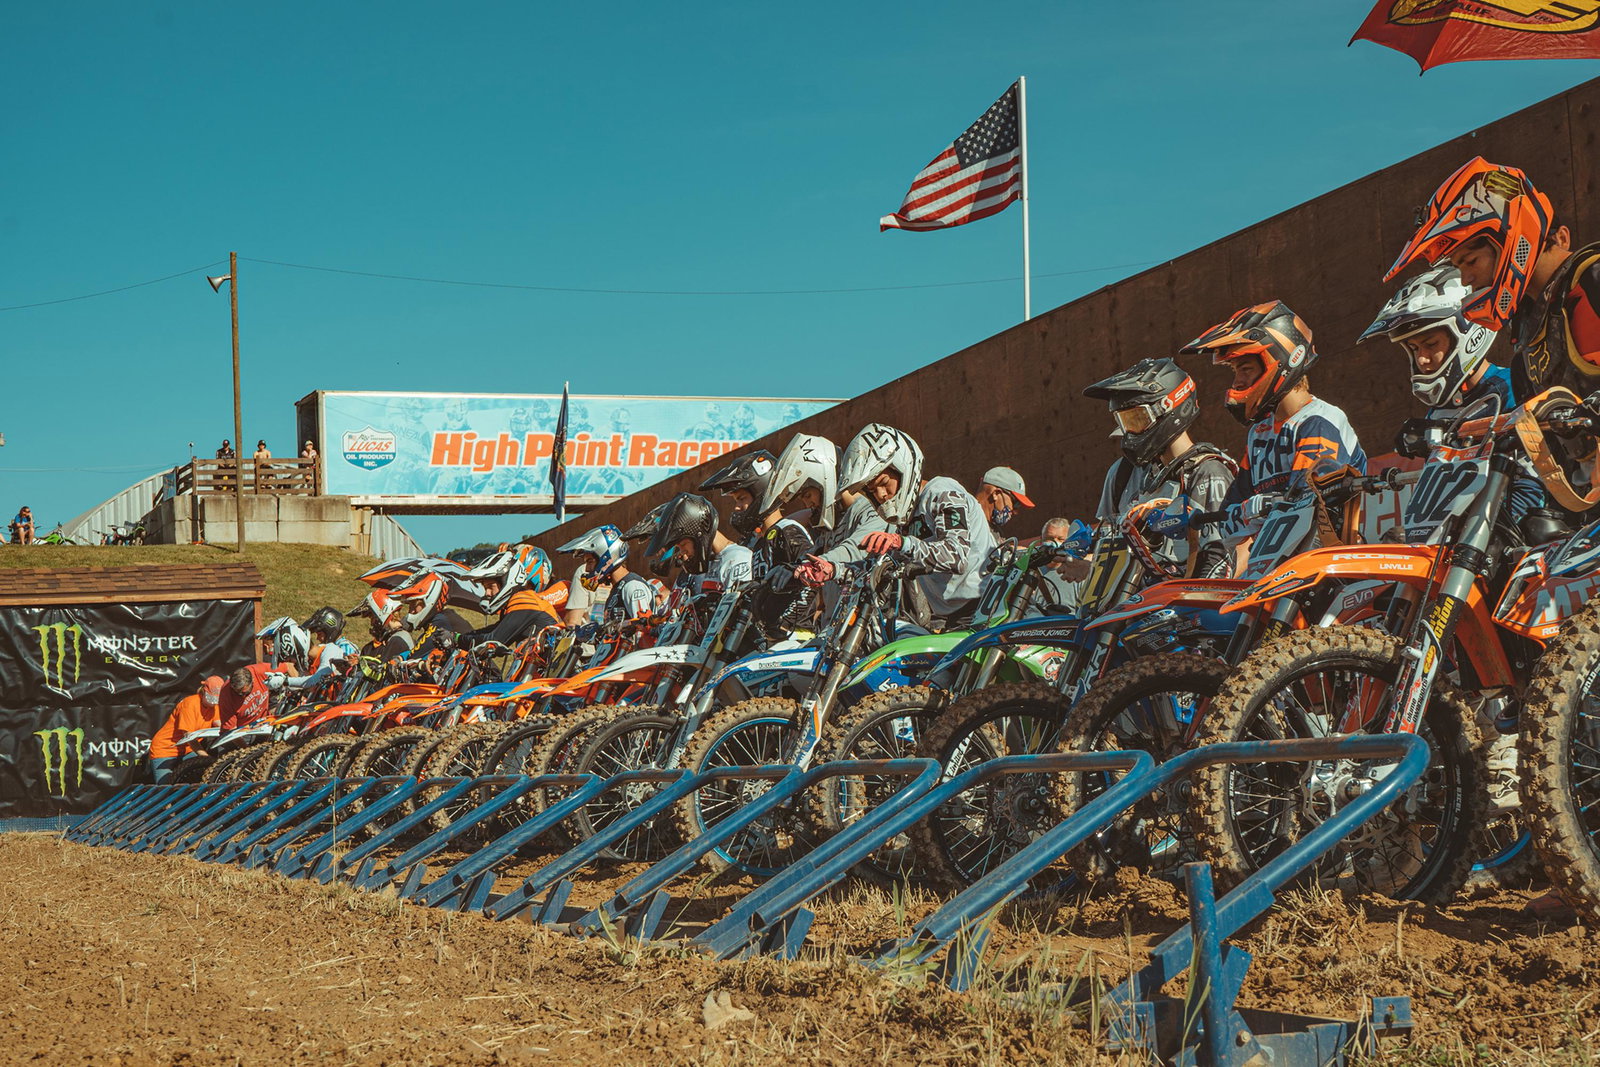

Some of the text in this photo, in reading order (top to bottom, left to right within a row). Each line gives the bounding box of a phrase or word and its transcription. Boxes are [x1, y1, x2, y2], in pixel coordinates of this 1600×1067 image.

[1470, 330, 1485, 348] Arai
[1291, 349, 1304, 365] BELL
[348, 441, 393, 451] LUCAS
[430, 431, 520, 473] High
[1333, 553, 1415, 561] ROOST
[1433, 597, 1455, 643] ction
